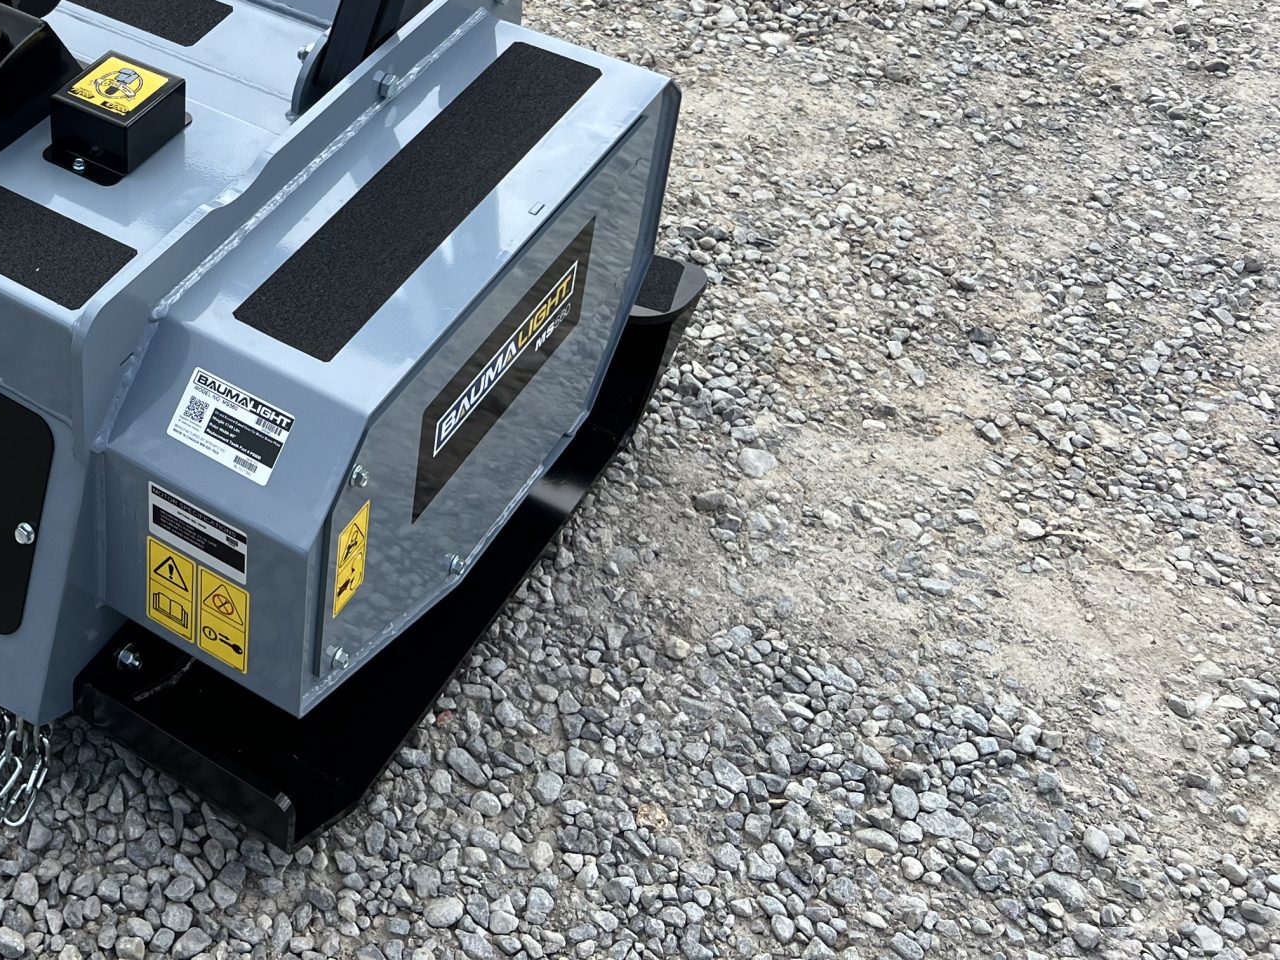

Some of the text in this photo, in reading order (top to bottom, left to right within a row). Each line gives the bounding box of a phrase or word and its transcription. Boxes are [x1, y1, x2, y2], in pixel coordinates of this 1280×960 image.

[440, 274, 572, 442] BAUMALIGHT
[193, 384, 211, 397] MODEL
[195, 373, 292, 429] BAUMALIGHT
[152, 488, 178, 508] MOTOR
[180, 503, 237, 538] SPECIFICATIONS
